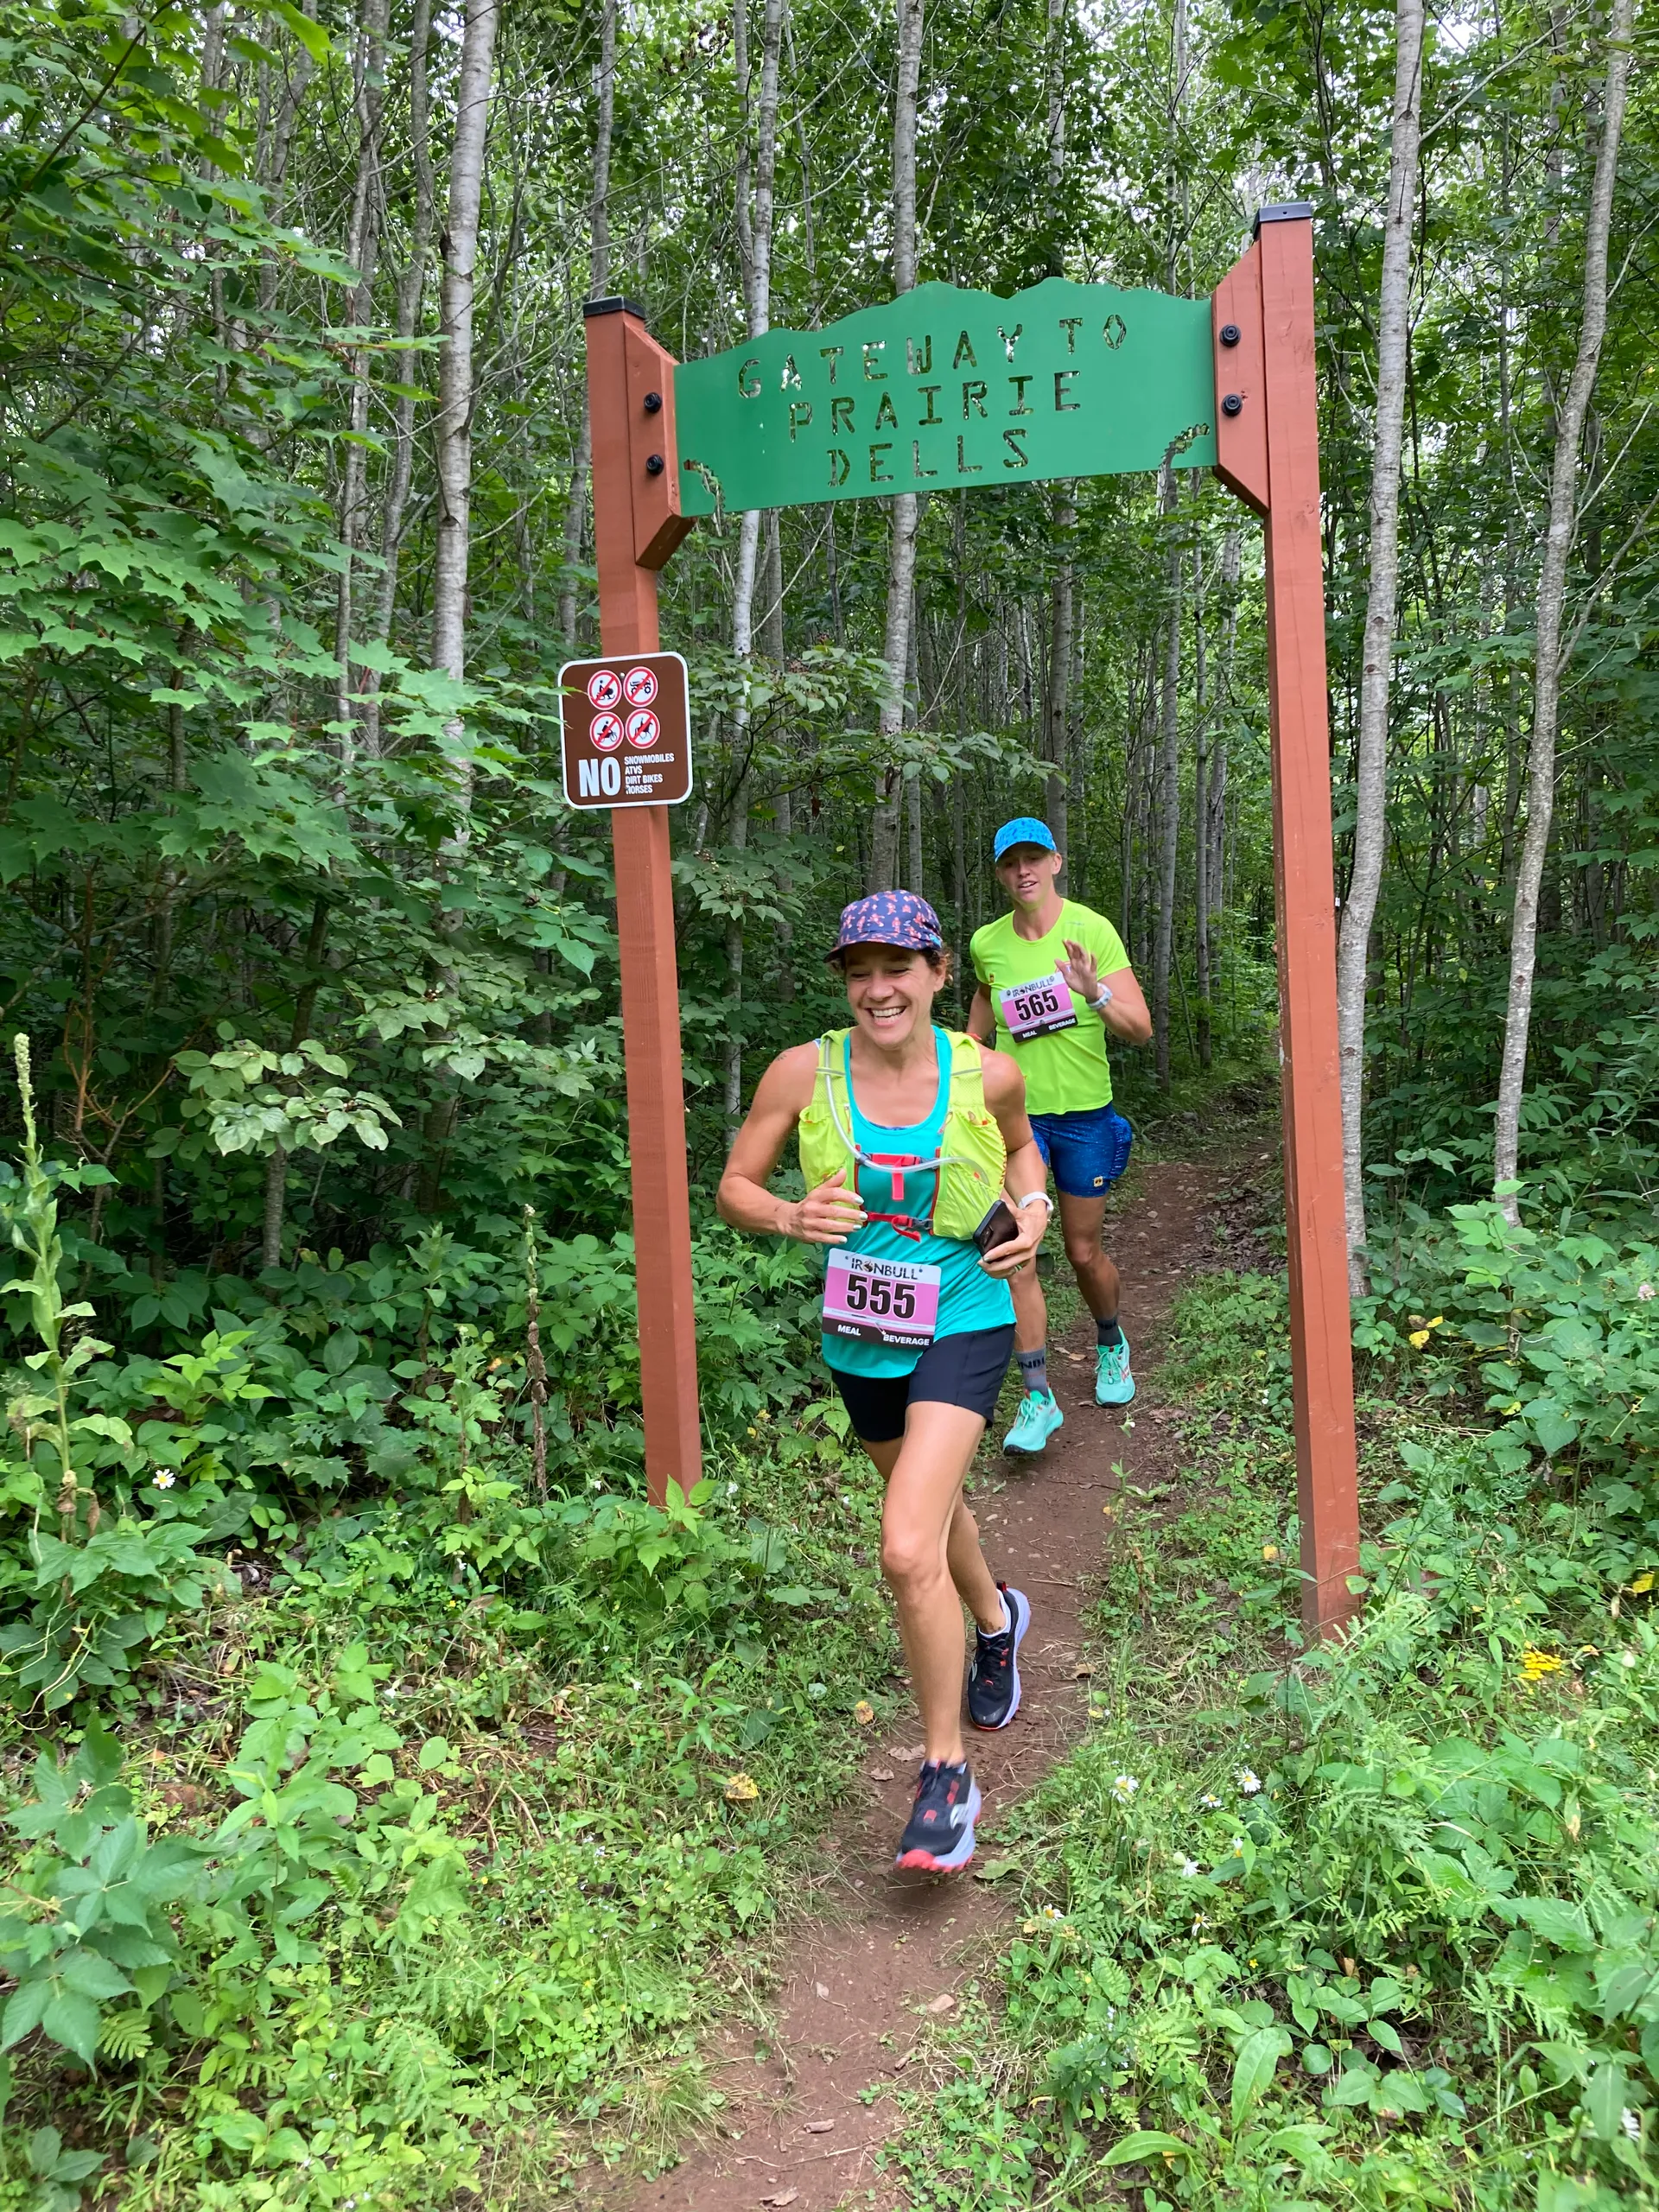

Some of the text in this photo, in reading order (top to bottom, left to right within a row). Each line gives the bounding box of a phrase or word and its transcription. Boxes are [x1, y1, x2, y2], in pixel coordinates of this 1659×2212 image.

[738, 314, 1128, 398] GATEWAY TO
[788, 371, 1081, 442] PRAIRIE
[827, 428, 1029, 486] DELLS
[624, 753, 674, 765] SNOWMOBILES
[578, 757, 620, 797] NO
[643, 773, 663, 784] BIKES
[1014, 988, 1059, 1021] 565
[1022, 1030, 1037, 1039] MEAL
[1048, 1018, 1076, 1031] BEVERAGE
[847, 1274, 915, 1319] 555
[837, 1324, 861, 1337] MEAL
[882, 1333, 930, 1346] BEVERAGE
